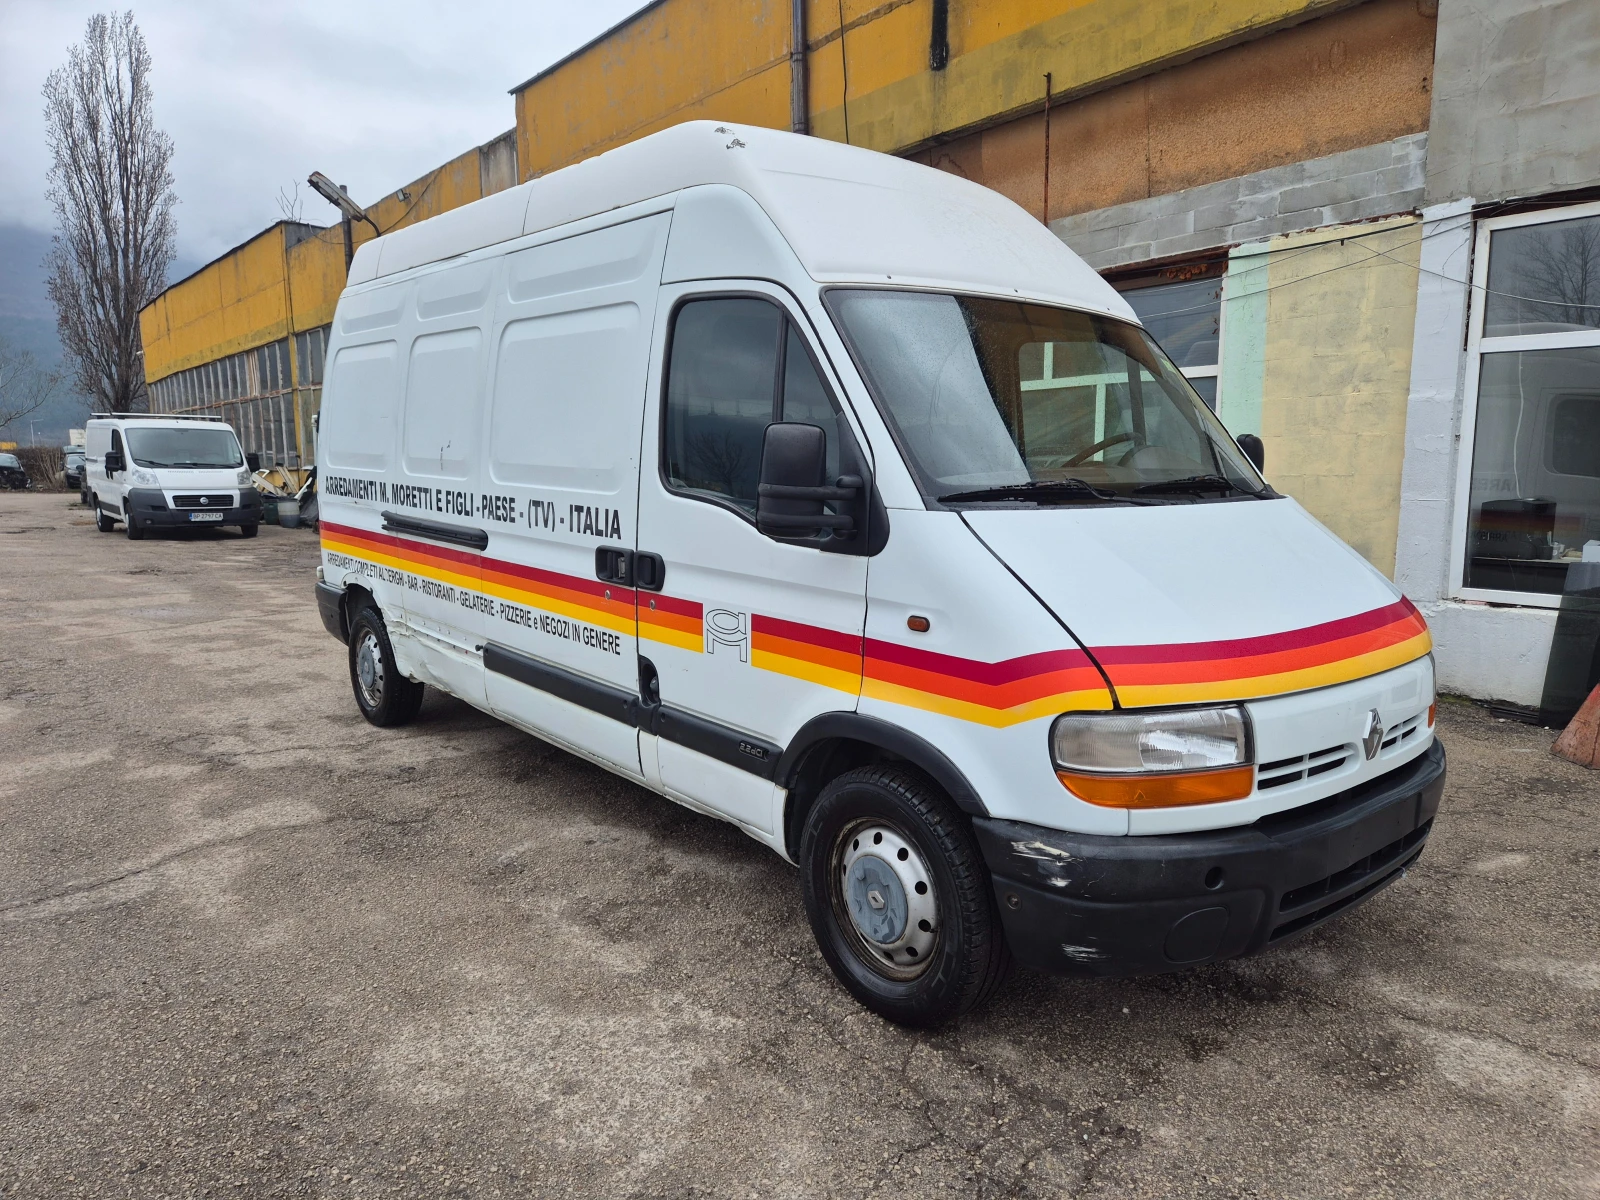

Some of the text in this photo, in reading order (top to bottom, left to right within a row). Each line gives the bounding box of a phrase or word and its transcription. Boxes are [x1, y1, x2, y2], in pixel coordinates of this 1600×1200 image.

[325, 475, 377, 502] ARREDAMENTI
[379, 481, 389, 504] M.
[391, 482, 433, 511] MORETTI
[435, 488, 443, 512] E
[445, 490, 474, 517] FIGLI
[481, 494, 516, 524] PAESE
[527, 499, 556, 532] (TV)
[569, 504, 622, 540] ITALIA
[422, 579, 456, 603] RISTORANTI
[459, 592, 495, 617] GELATERIE
[500, 602, 532, 630] PIZZERIE
[533, 618, 538, 630] e
[539, 614, 570, 640] NEGOZI
[572, 624, 581, 643] IN
[582, 626, 621, 656] GENERE
